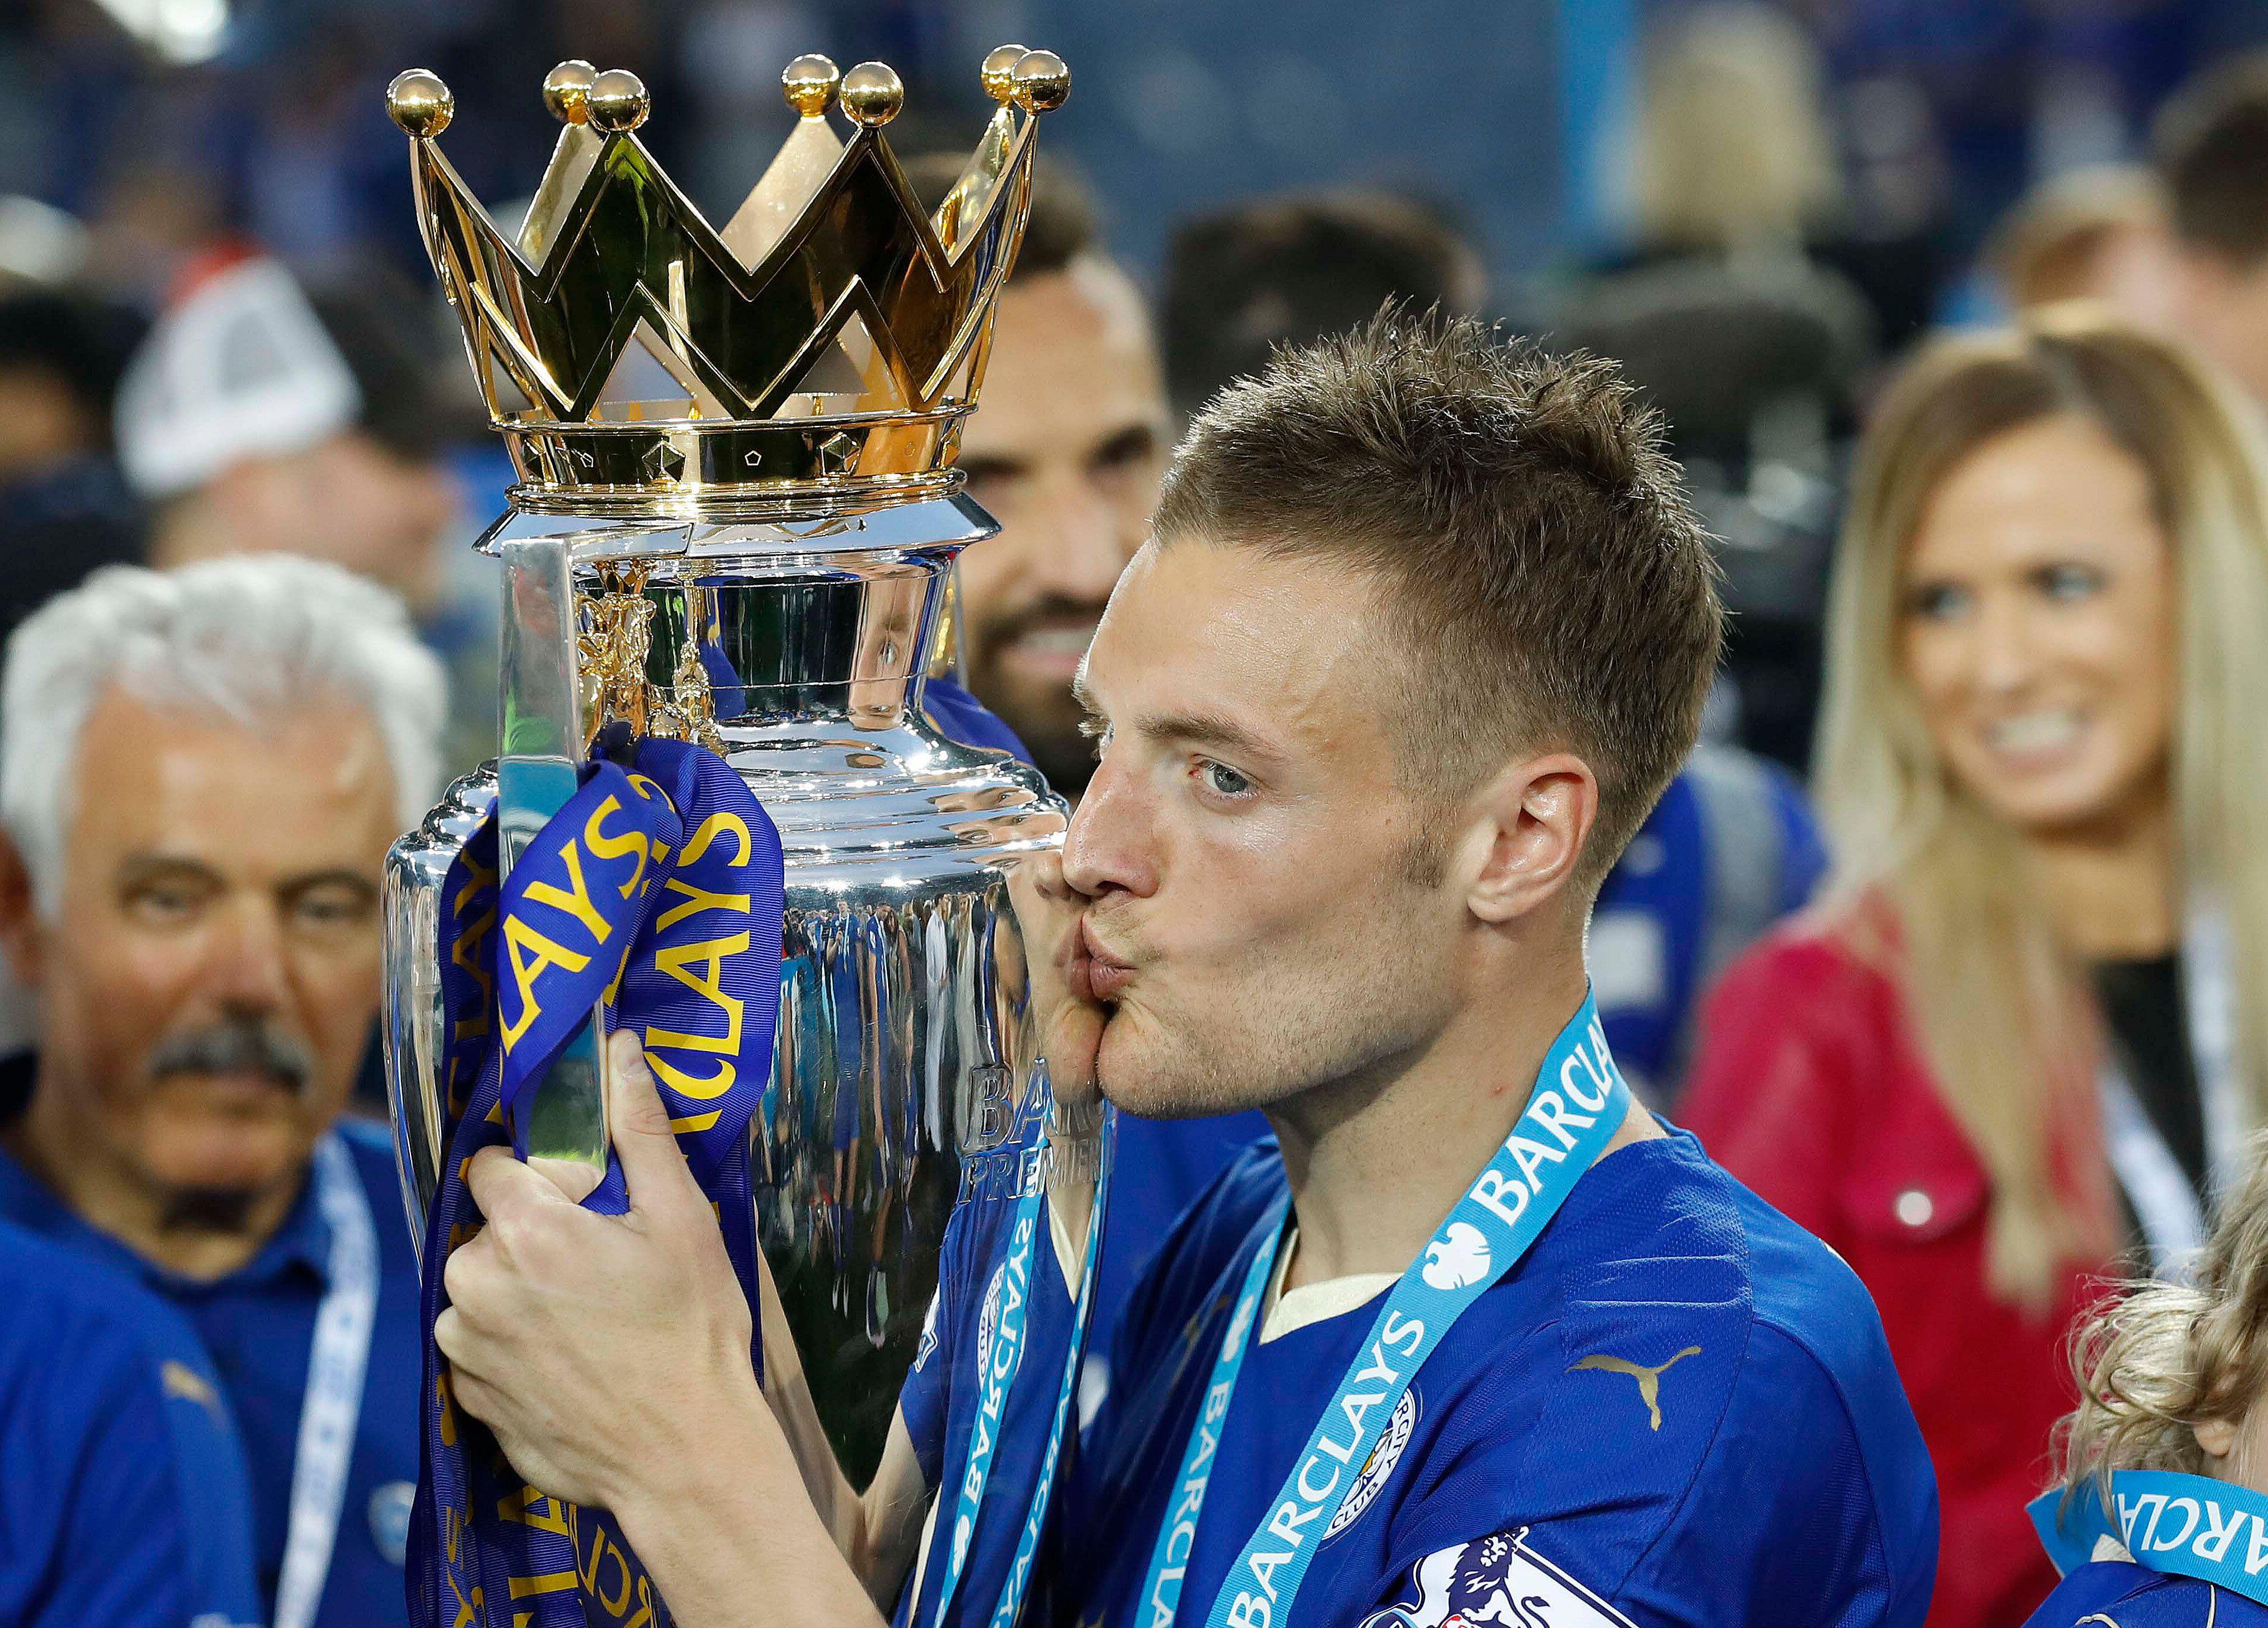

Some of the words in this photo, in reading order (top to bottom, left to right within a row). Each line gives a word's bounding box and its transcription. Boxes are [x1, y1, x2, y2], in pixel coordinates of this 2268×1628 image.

[1470, 1014, 1615, 1227] BARCLA
[1226, 1310, 1425, 1628] BARCLAYS
[1332, 1482, 1379, 1529] CLUB
[2112, 1493, 2268, 1576] ARCLA
